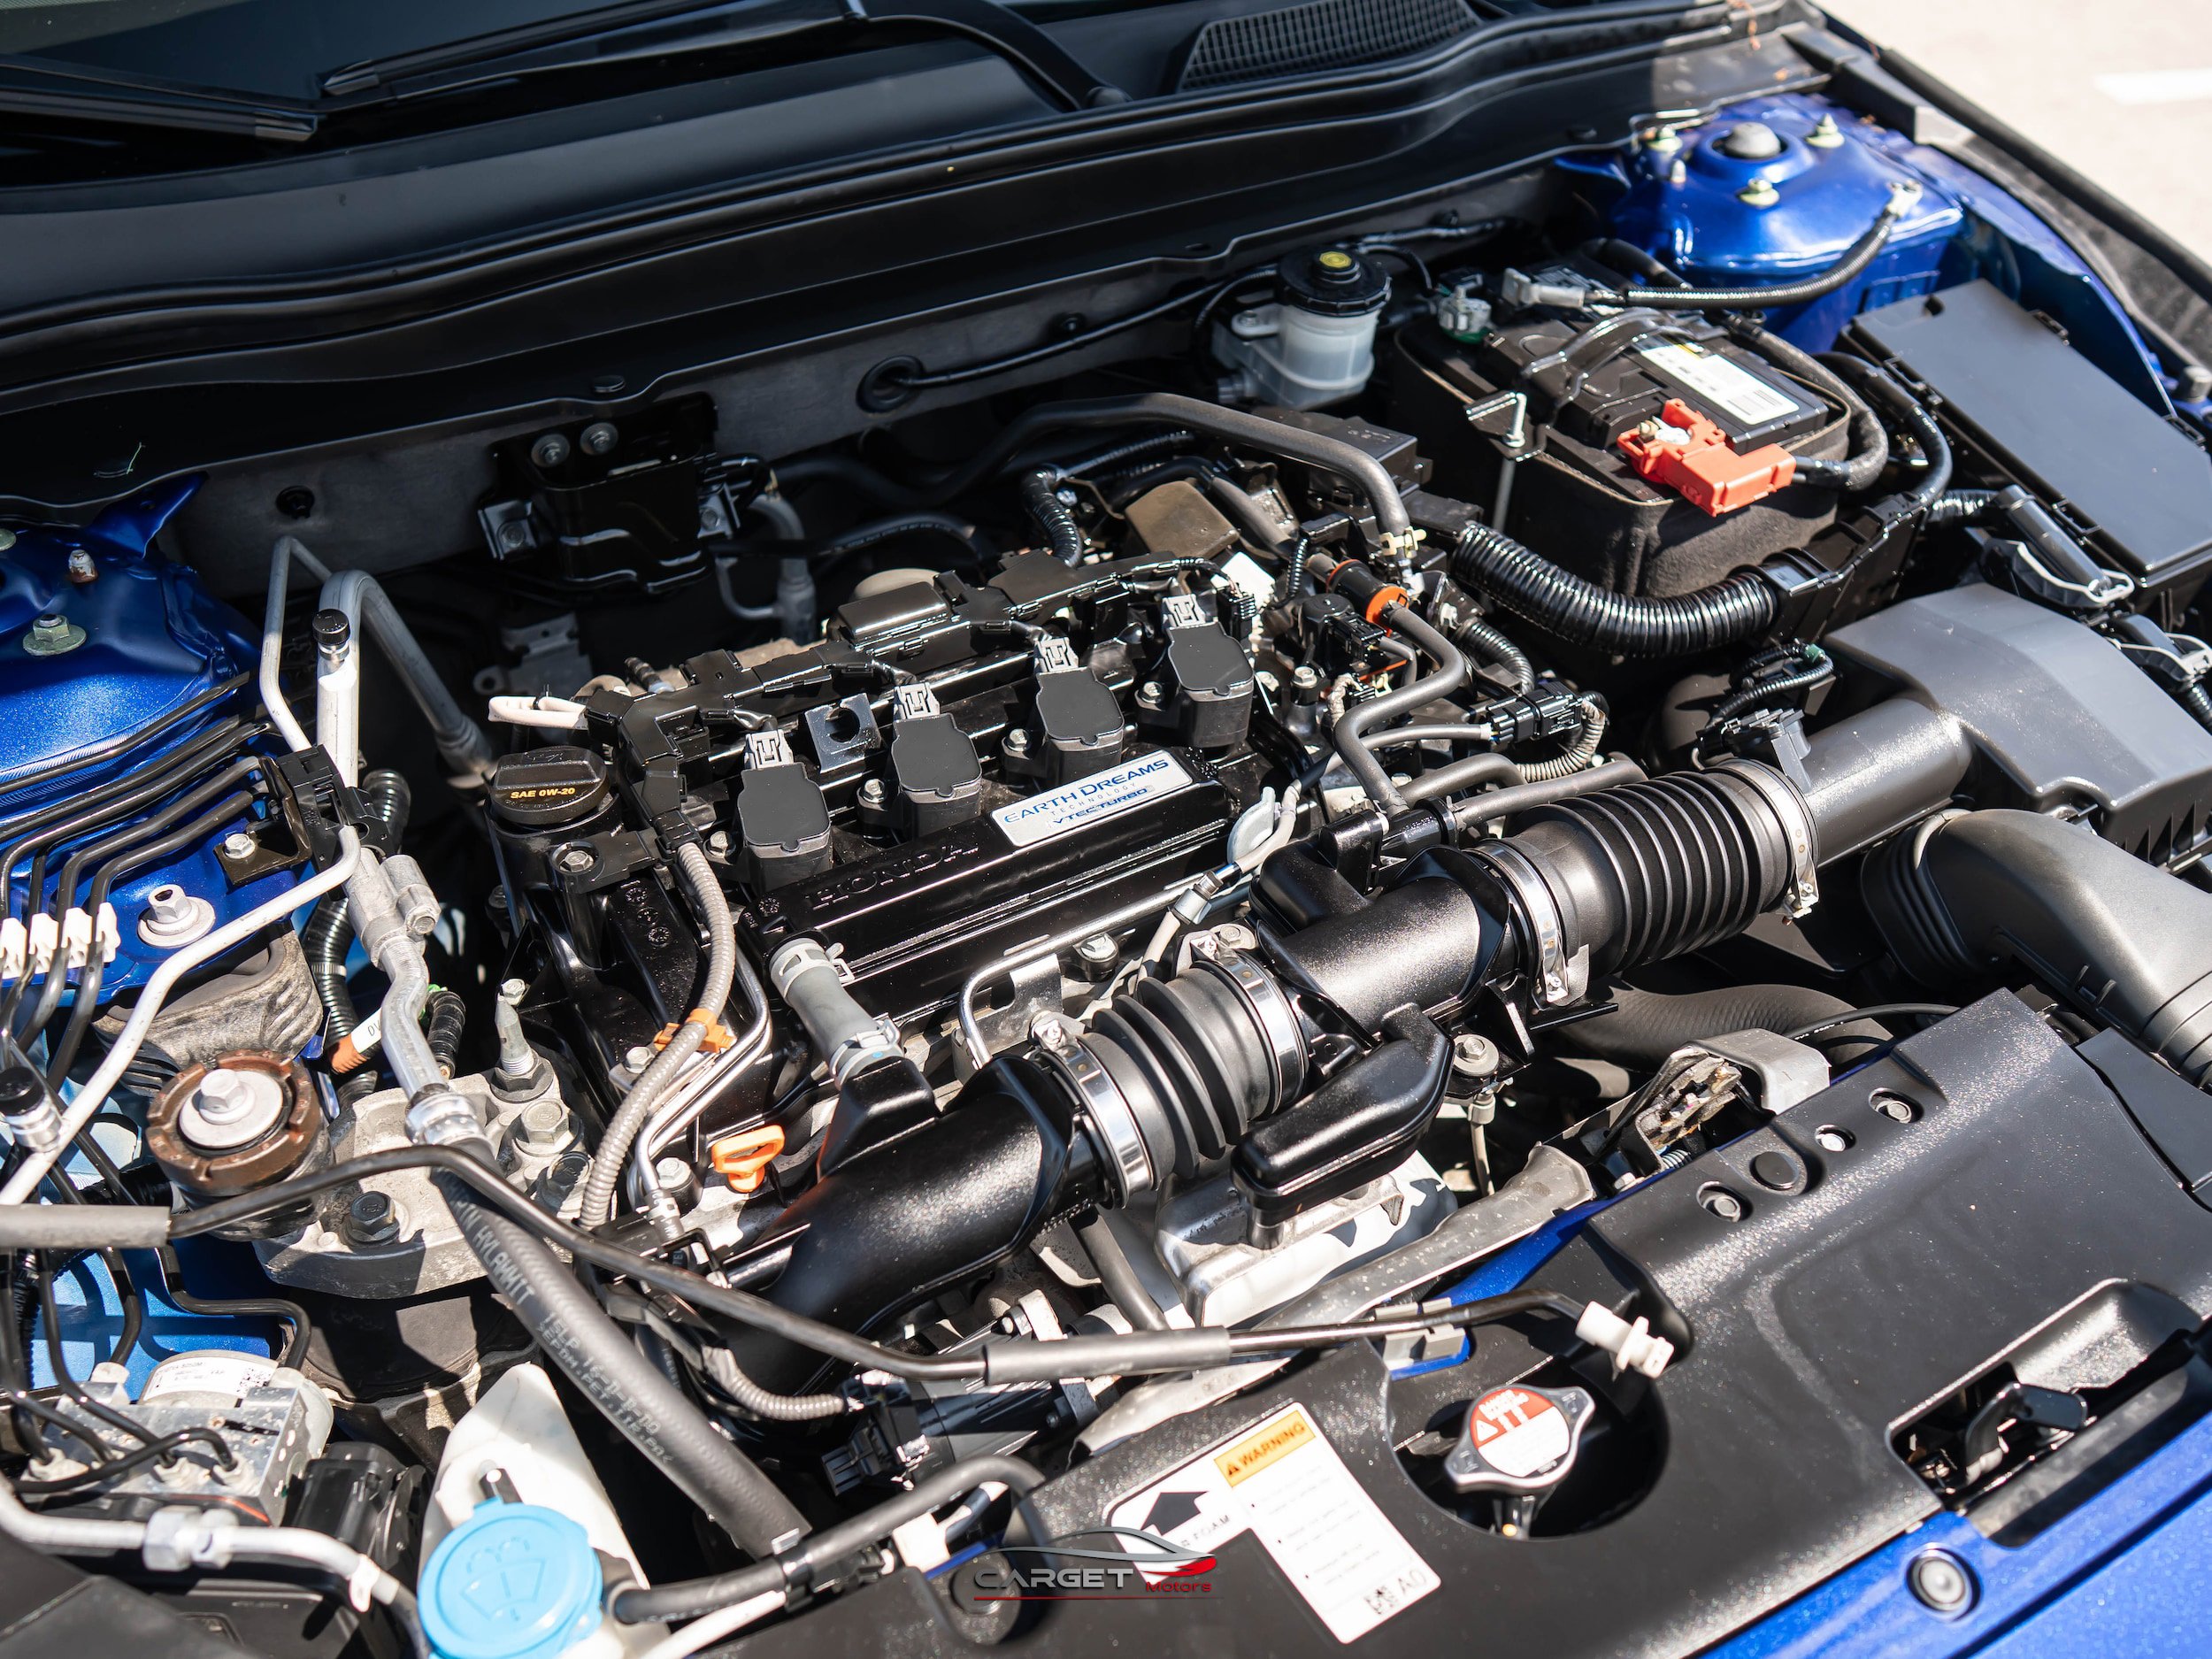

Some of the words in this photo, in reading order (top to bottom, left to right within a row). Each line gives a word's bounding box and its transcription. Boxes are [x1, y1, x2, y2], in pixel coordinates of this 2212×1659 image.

[511, 789, 537, 799] SAE
[538, 787, 576, 797] 0W-20
[1003, 792, 1078, 824] EARTH
[1078, 758, 1170, 795] DREAMS
[1050, 781, 1137, 816] TECHNOLOGY
[805, 843, 979, 910] HONDA
[1239, 1421, 1306, 1466] WARNING
